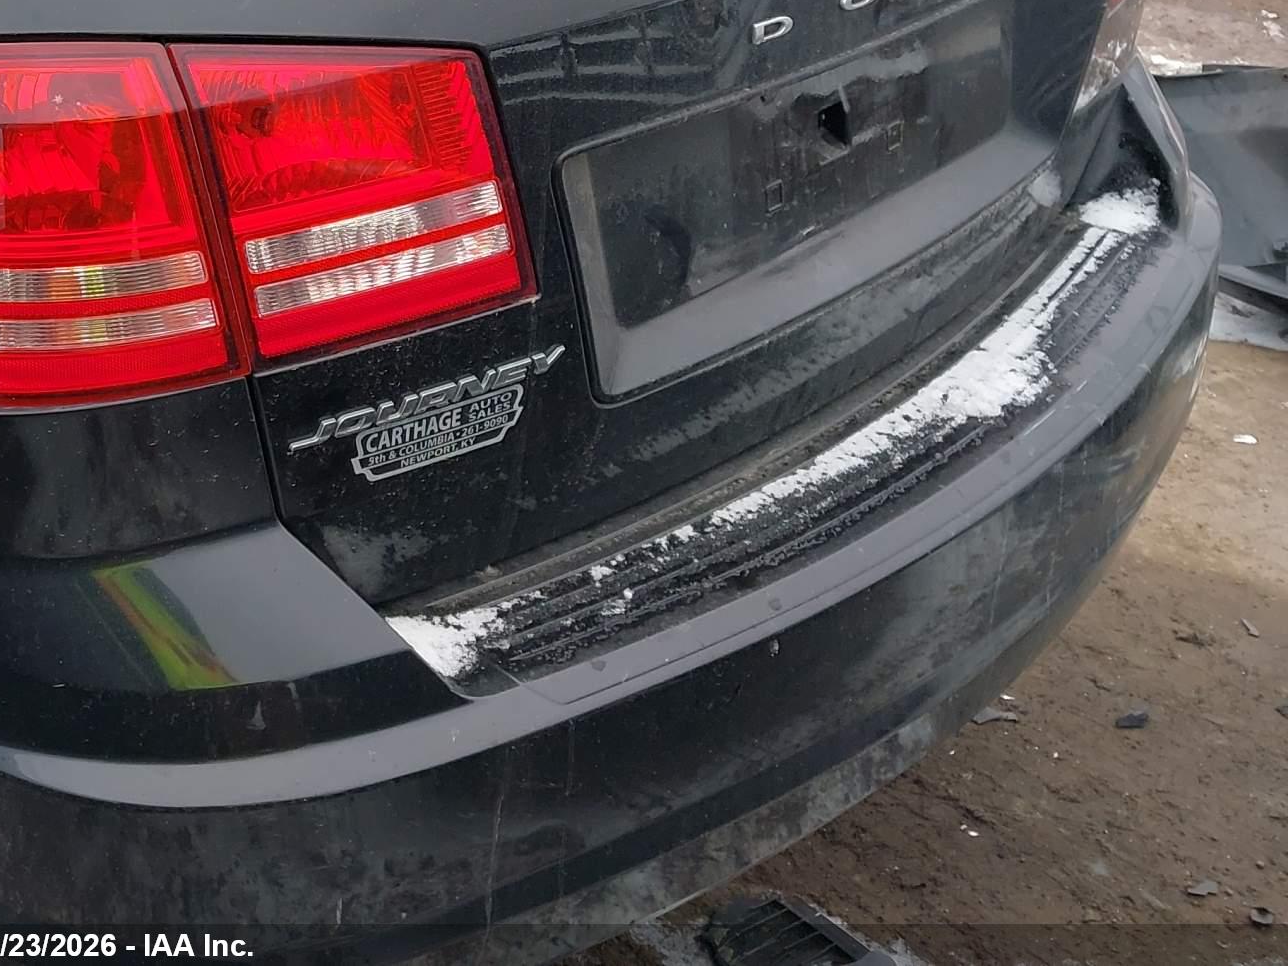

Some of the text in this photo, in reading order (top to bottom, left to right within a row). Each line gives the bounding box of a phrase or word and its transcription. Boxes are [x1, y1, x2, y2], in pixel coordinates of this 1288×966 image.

[287, 344, 566, 453] JOURNEY
[365, 391, 513, 453] CARTHAGE AUTO
[468, 401, 511, 422] SALES
[368, 414, 509, 467] 9th & COLUMBIA 261-9090
[461, 437, 476, 449] KY
